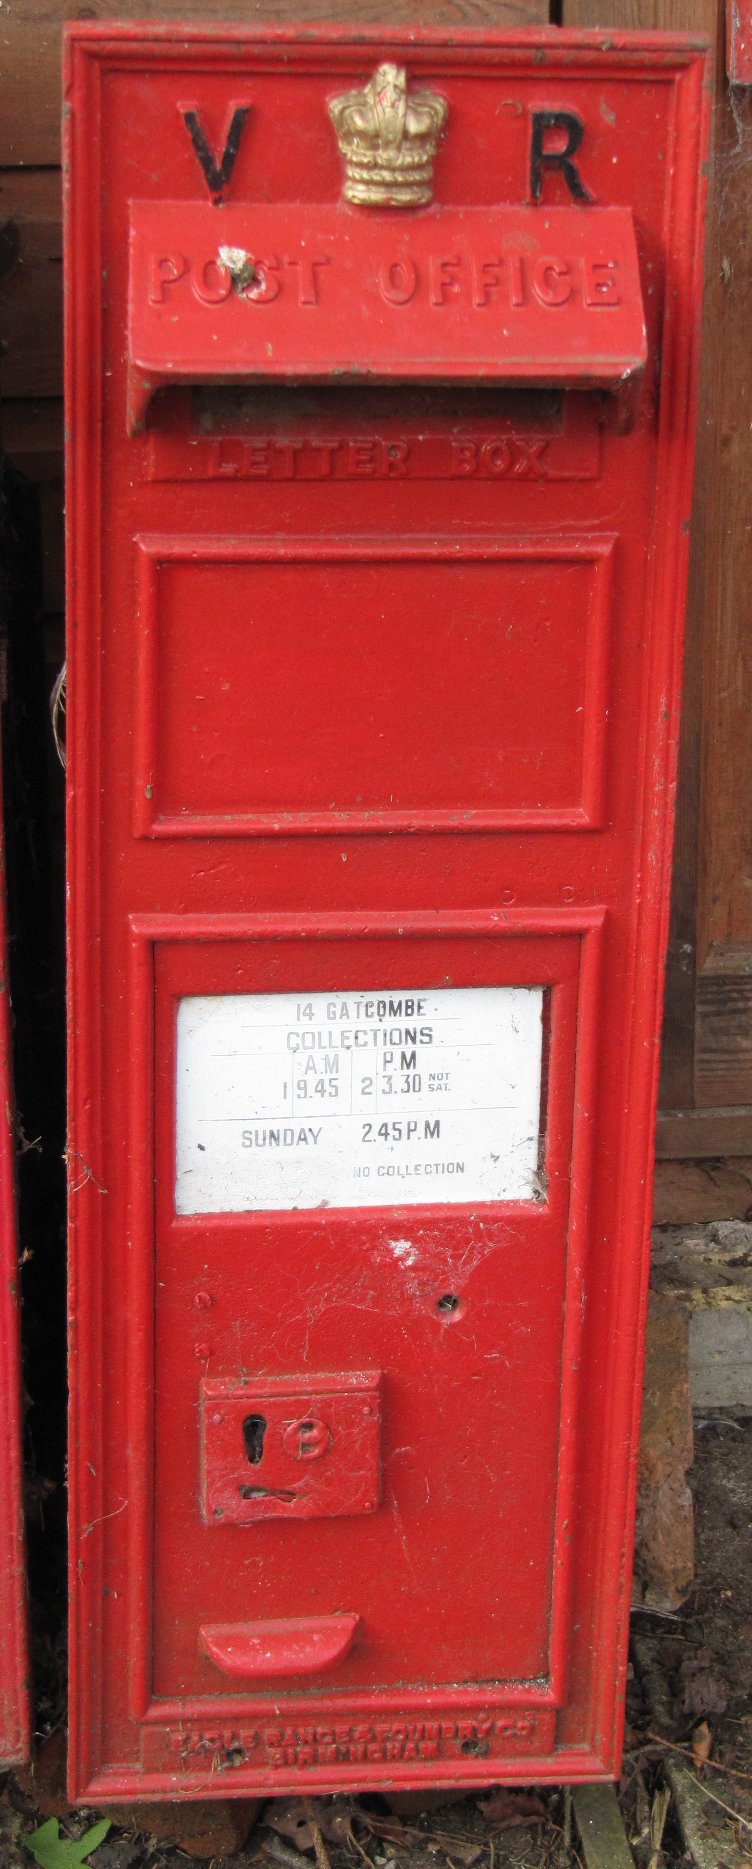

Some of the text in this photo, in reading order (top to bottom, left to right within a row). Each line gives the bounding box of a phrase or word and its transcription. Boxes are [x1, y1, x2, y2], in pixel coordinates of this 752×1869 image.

[177, 101, 598, 207] V R
[149, 252, 622, 310] POST OFFICE
[207, 437, 550, 479] LETTER BOX
[296, 998, 428, 1021] 14 GATCOMBE
[286, 1026, 433, 1050] COLLECTIONS
[382, 1050, 417, 1071] P.M
[296, 1078, 339, 1099] 9.45
[360, 1076, 373, 1096] 2
[381, 1073, 422, 1095] 3.30
[428, 1072, 451, 1081] NOT
[241, 1127, 322, 1148] SUNDAY
[353, 1162, 465, 1178] NO COLLECTION
